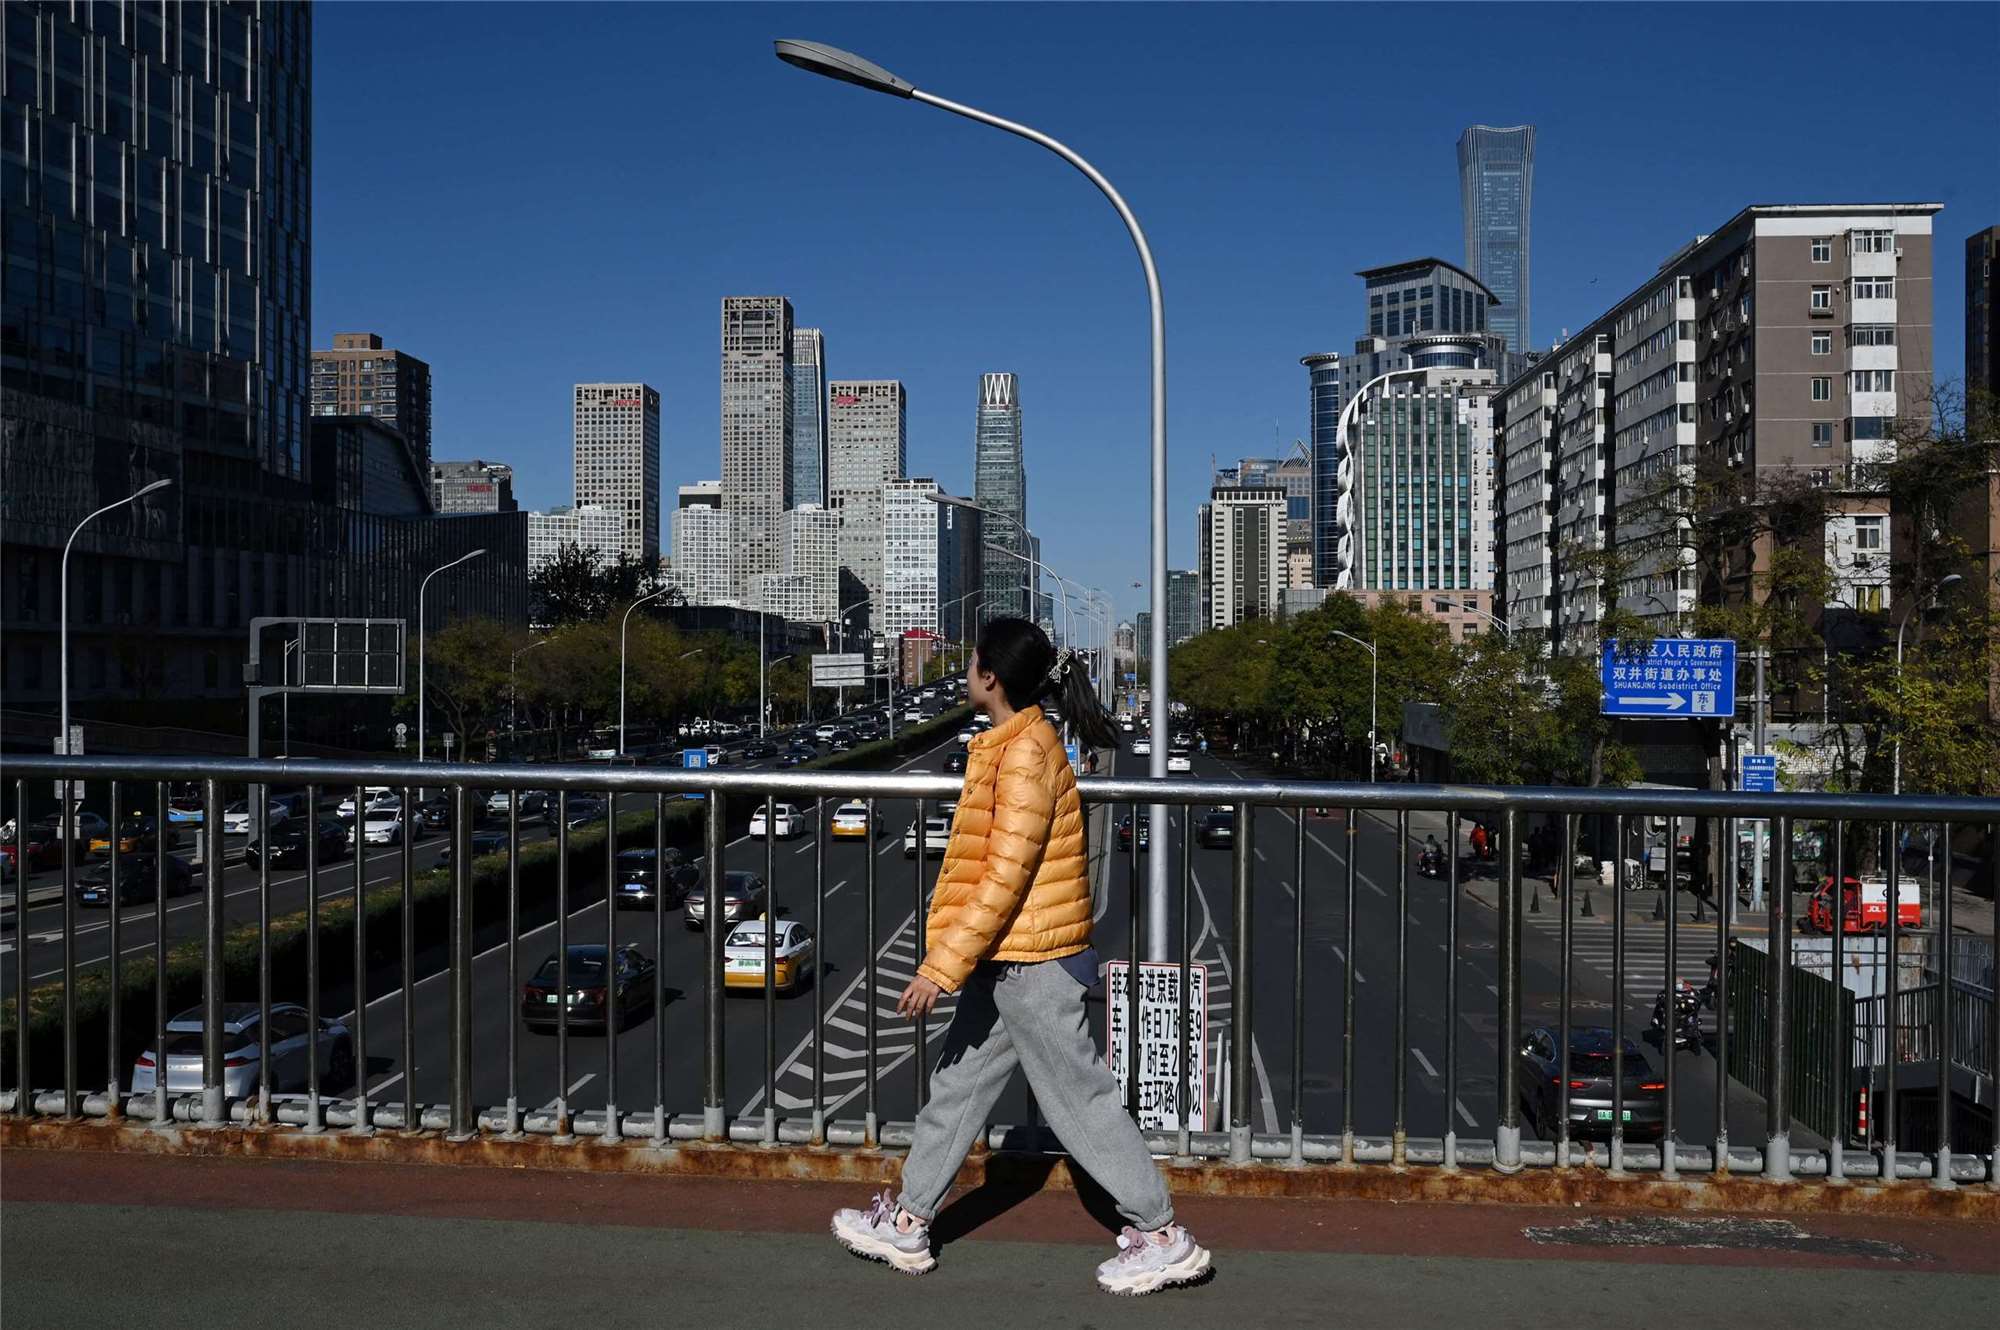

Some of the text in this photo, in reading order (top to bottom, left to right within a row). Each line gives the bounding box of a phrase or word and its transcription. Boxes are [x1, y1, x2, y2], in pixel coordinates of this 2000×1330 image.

[1614, 643, 1722, 658] 区人民政府
[1690, 659, 1722, 667] Government
[1613, 667, 1722, 682] 双井街道办事处
[1614, 681, 1721, 690] SHUANGJING Subdistrict Office
[1698, 693, 1709, 704] 东
